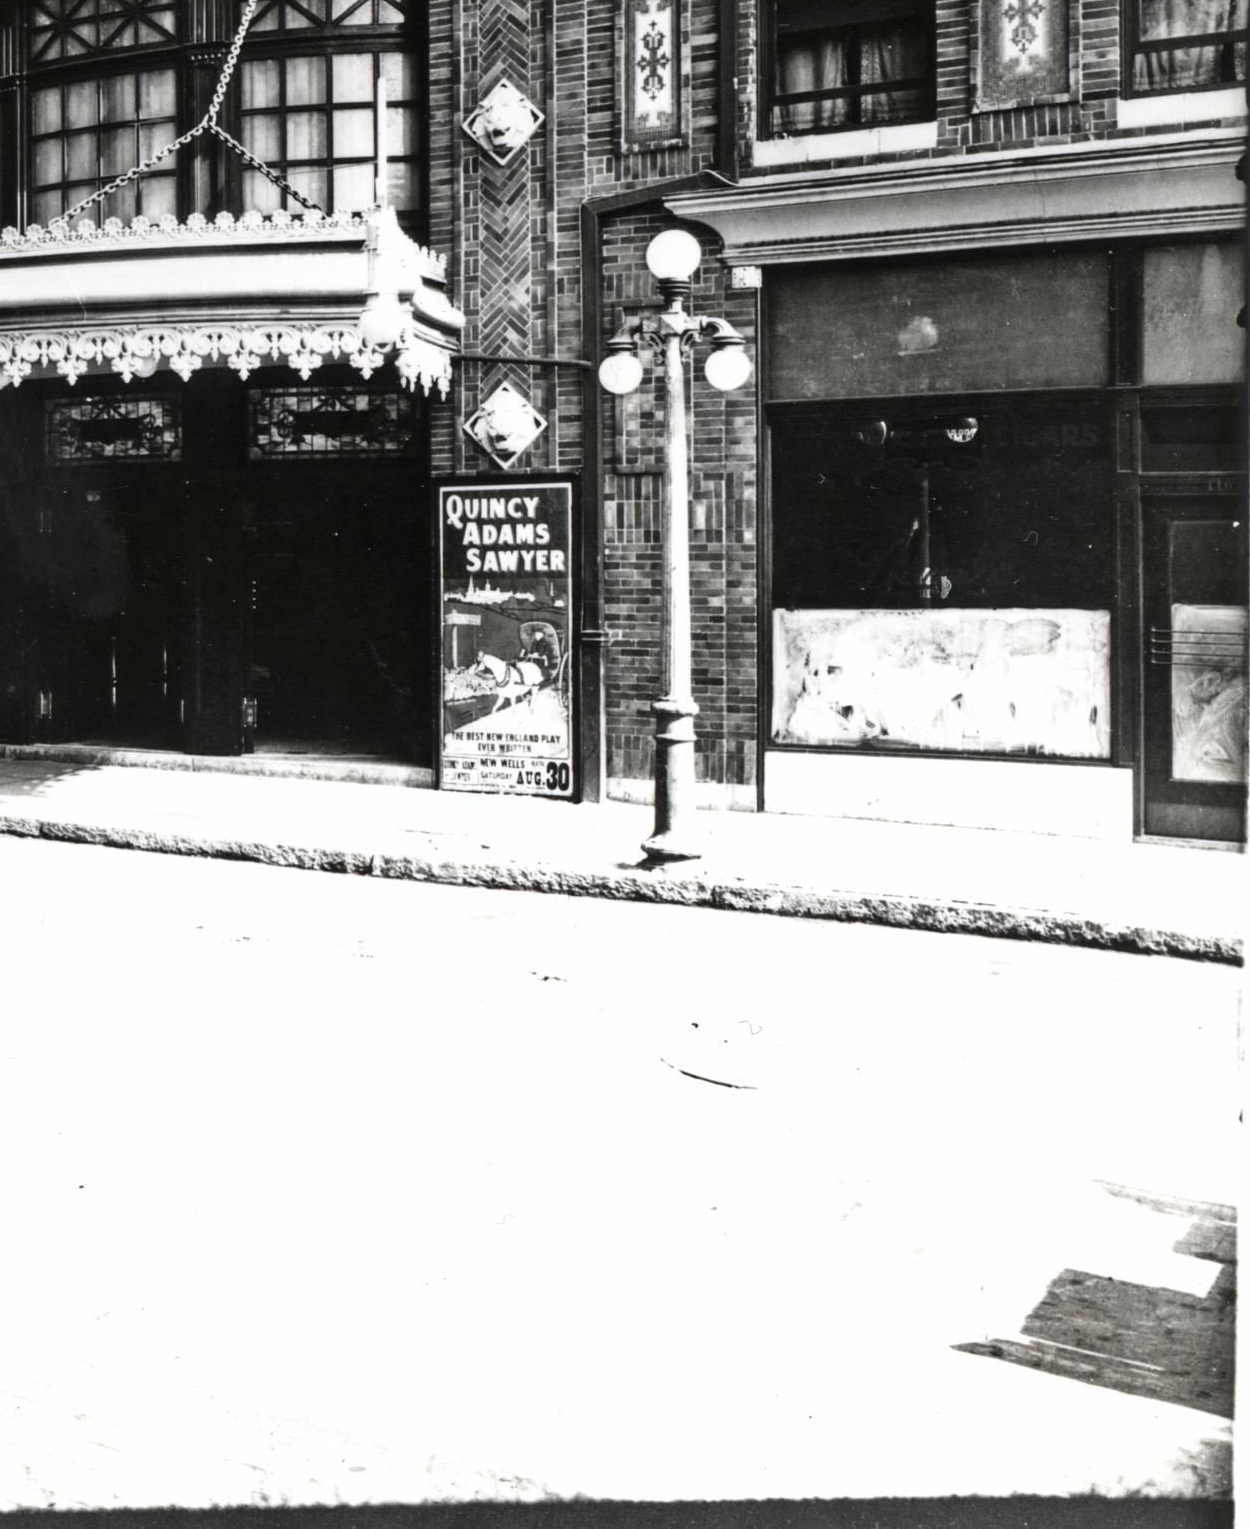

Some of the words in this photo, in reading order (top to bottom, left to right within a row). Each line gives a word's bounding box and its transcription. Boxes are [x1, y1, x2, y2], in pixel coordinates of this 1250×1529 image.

[446, 494, 540, 529] QUINCY
[462, 521, 551, 546] ADAMS
[466, 547, 566, 573] SAWYER
[451, 731, 464, 741] THE
[466, 732, 484, 741] BEST
[486, 732, 503, 742] NEW
[505, 733, 539, 743] ENGLAND
[541, 734, 561, 744] PLAY
[478, 743, 496, 752] EVER
[499, 743, 532, 753] WRITTEN
[480, 758, 497, 767] NEW
[500, 759, 525, 769] WELLS
[480, 771, 512, 780] SATURDAY
[516, 770, 546, 786] AUG.
[546, 761, 570, 792] 30
